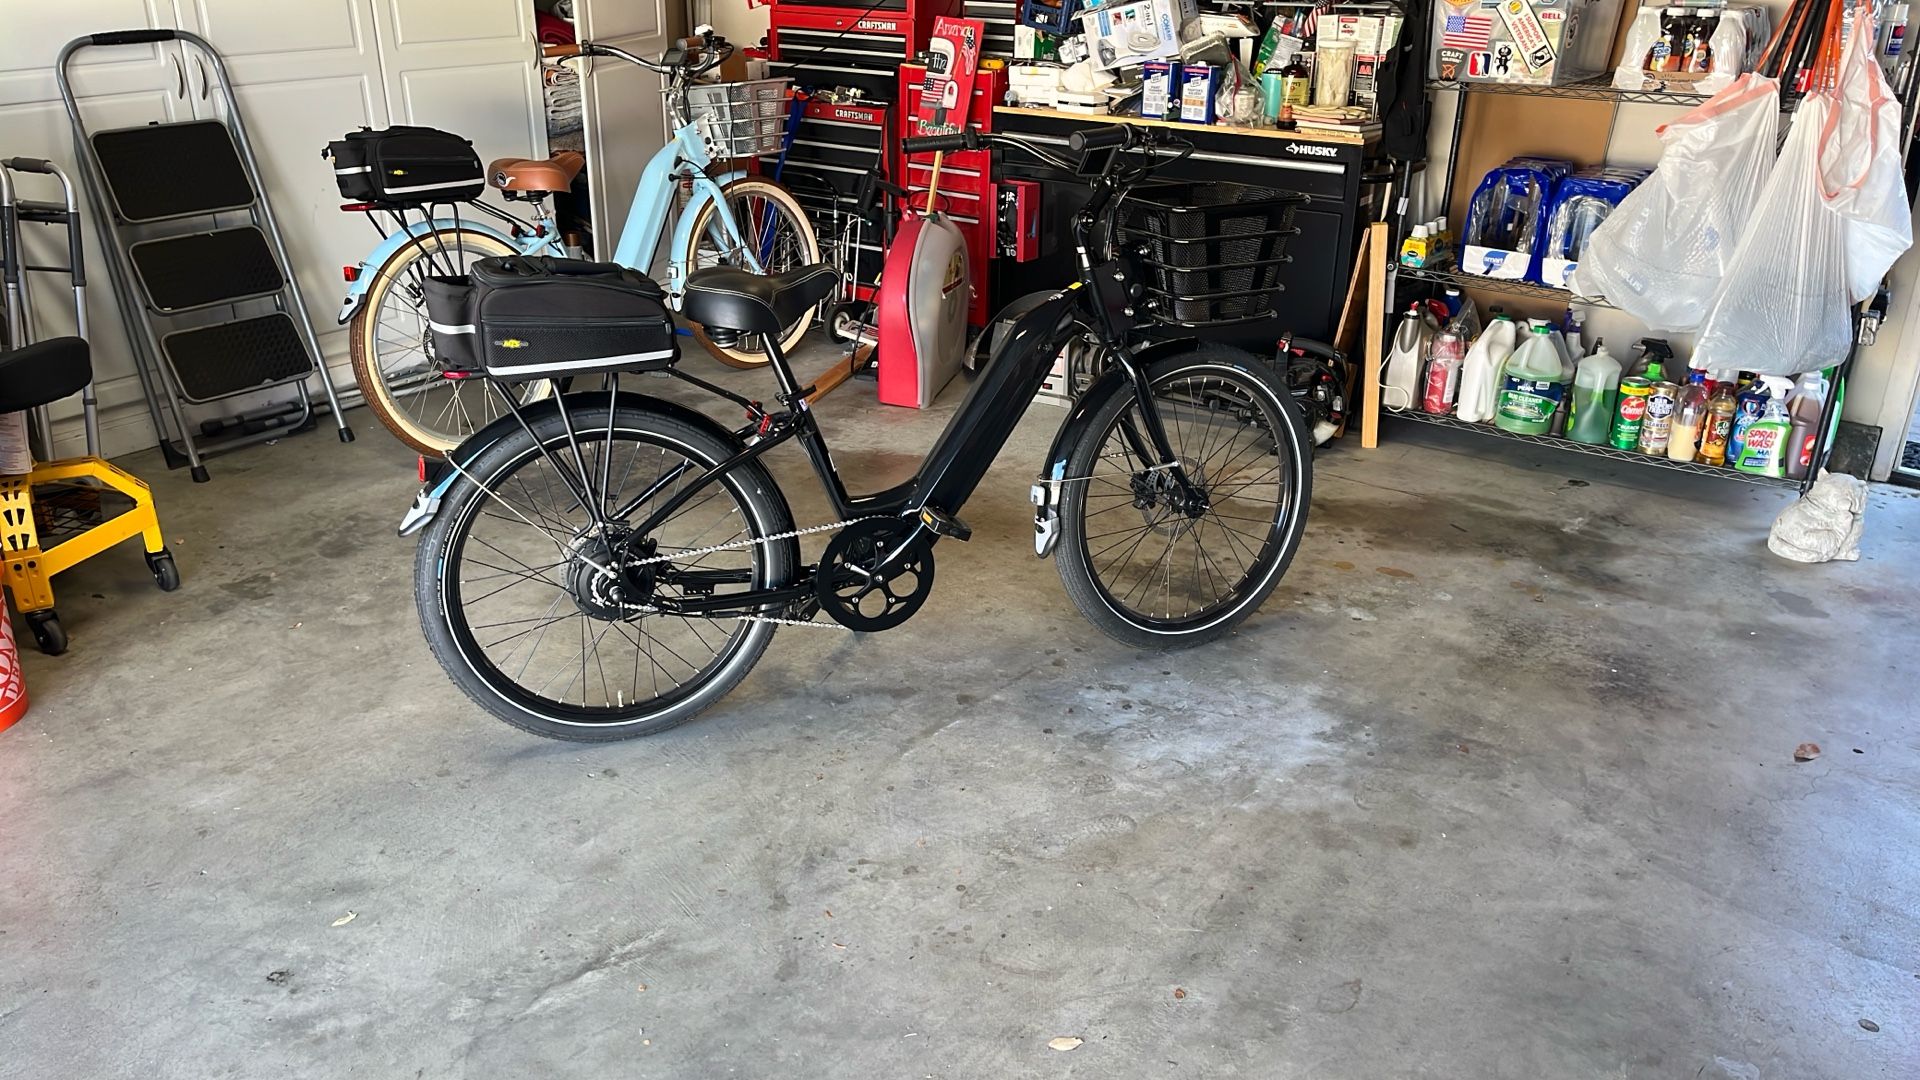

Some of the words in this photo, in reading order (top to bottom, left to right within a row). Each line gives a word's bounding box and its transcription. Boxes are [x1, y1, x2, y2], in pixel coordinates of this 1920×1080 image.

[1541, 12, 1562, 20] BELL
[857, 20, 897, 31] CRAFTSMAN
[1525, 16, 1543, 43] SUPPORT
[1511, 21, 1531, 53] VETERANS
[1518, 17, 1537, 49] AMERICA'S
[1441, 49, 1464, 60] CRAFT
[932, 52, 948, 70] the
[835, 109, 873, 121] CRAFTSMAN
[1299, 145, 1338, 157] HUSKY
[1518, 395, 1543, 404] CLEANER
[1621, 404, 1644, 415] Comet
[1757, 449, 1772, 457] MA
